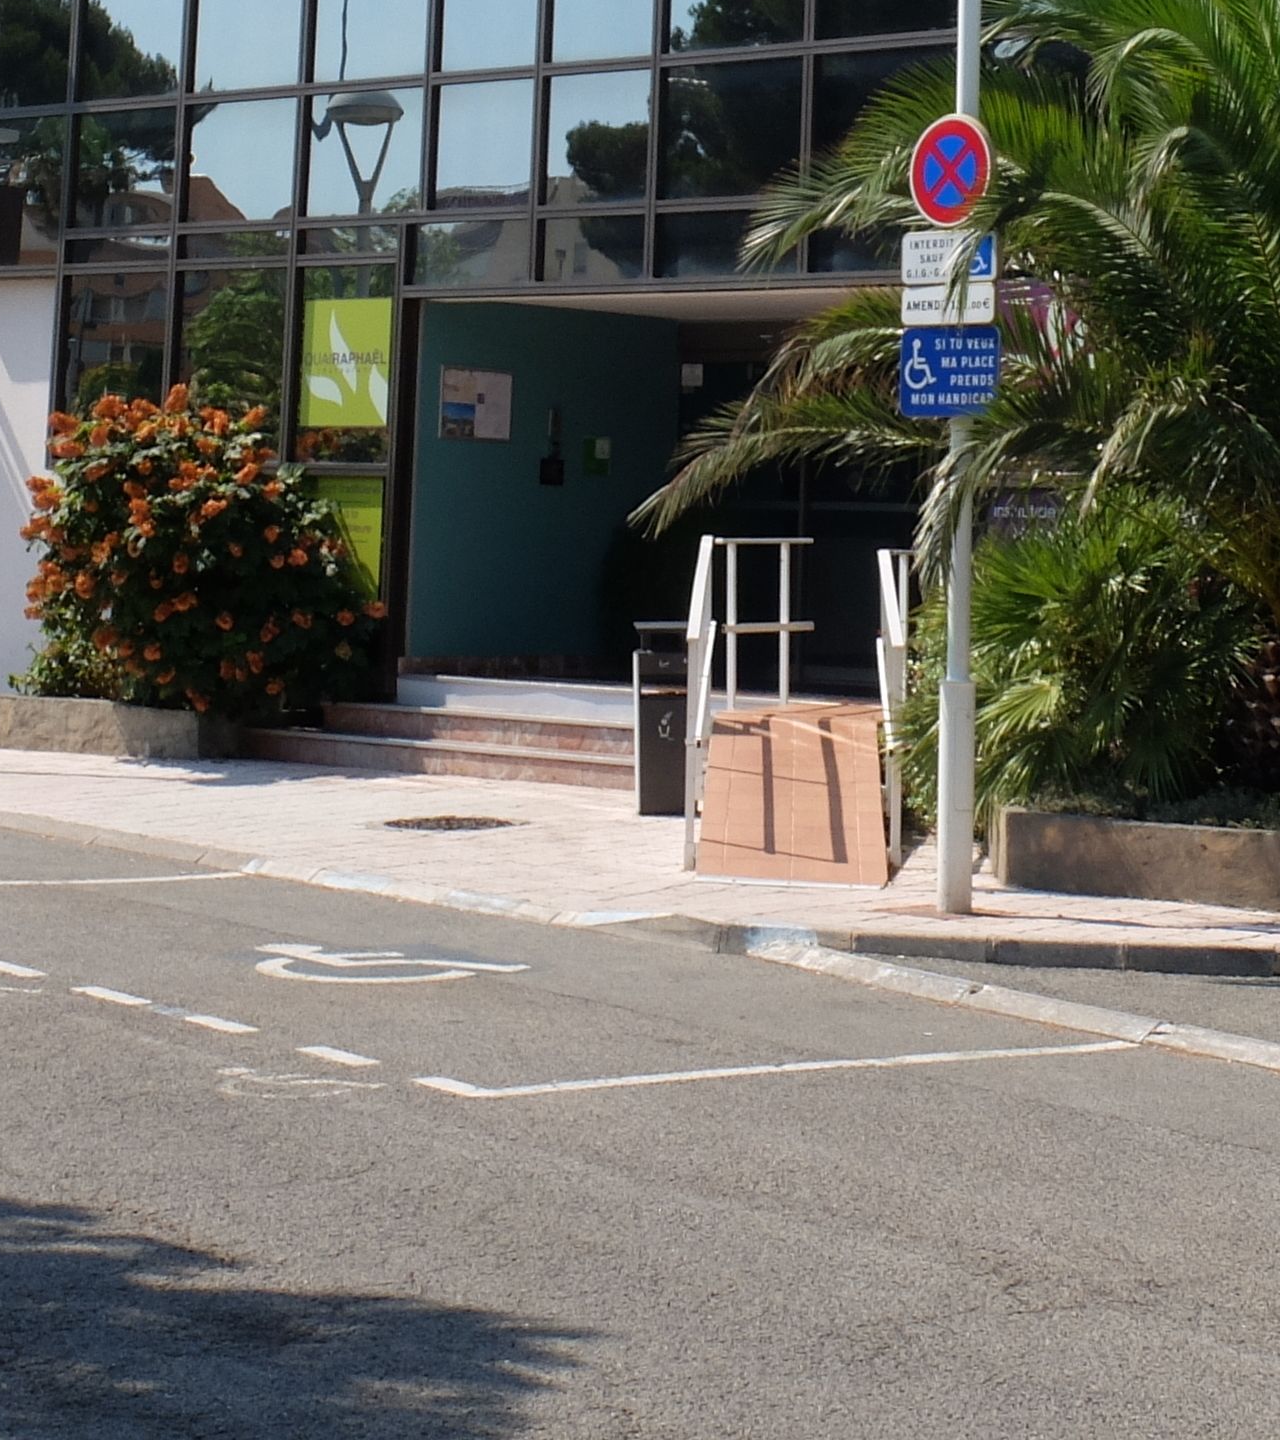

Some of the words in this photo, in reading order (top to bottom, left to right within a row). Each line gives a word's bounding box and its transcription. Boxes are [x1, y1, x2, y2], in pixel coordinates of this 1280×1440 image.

[909, 238, 955, 250] INTERDIT
[919, 253, 945, 264] SAUF
[934, 338, 946, 350] SI
[949, 338, 963, 350] TU
[966, 338, 995, 350] VEUX
[941, 356, 957, 368] MA
[961, 355, 995, 368] PLACE
[949, 374, 994, 386] PRENDS
[910, 393, 935, 405] MON
